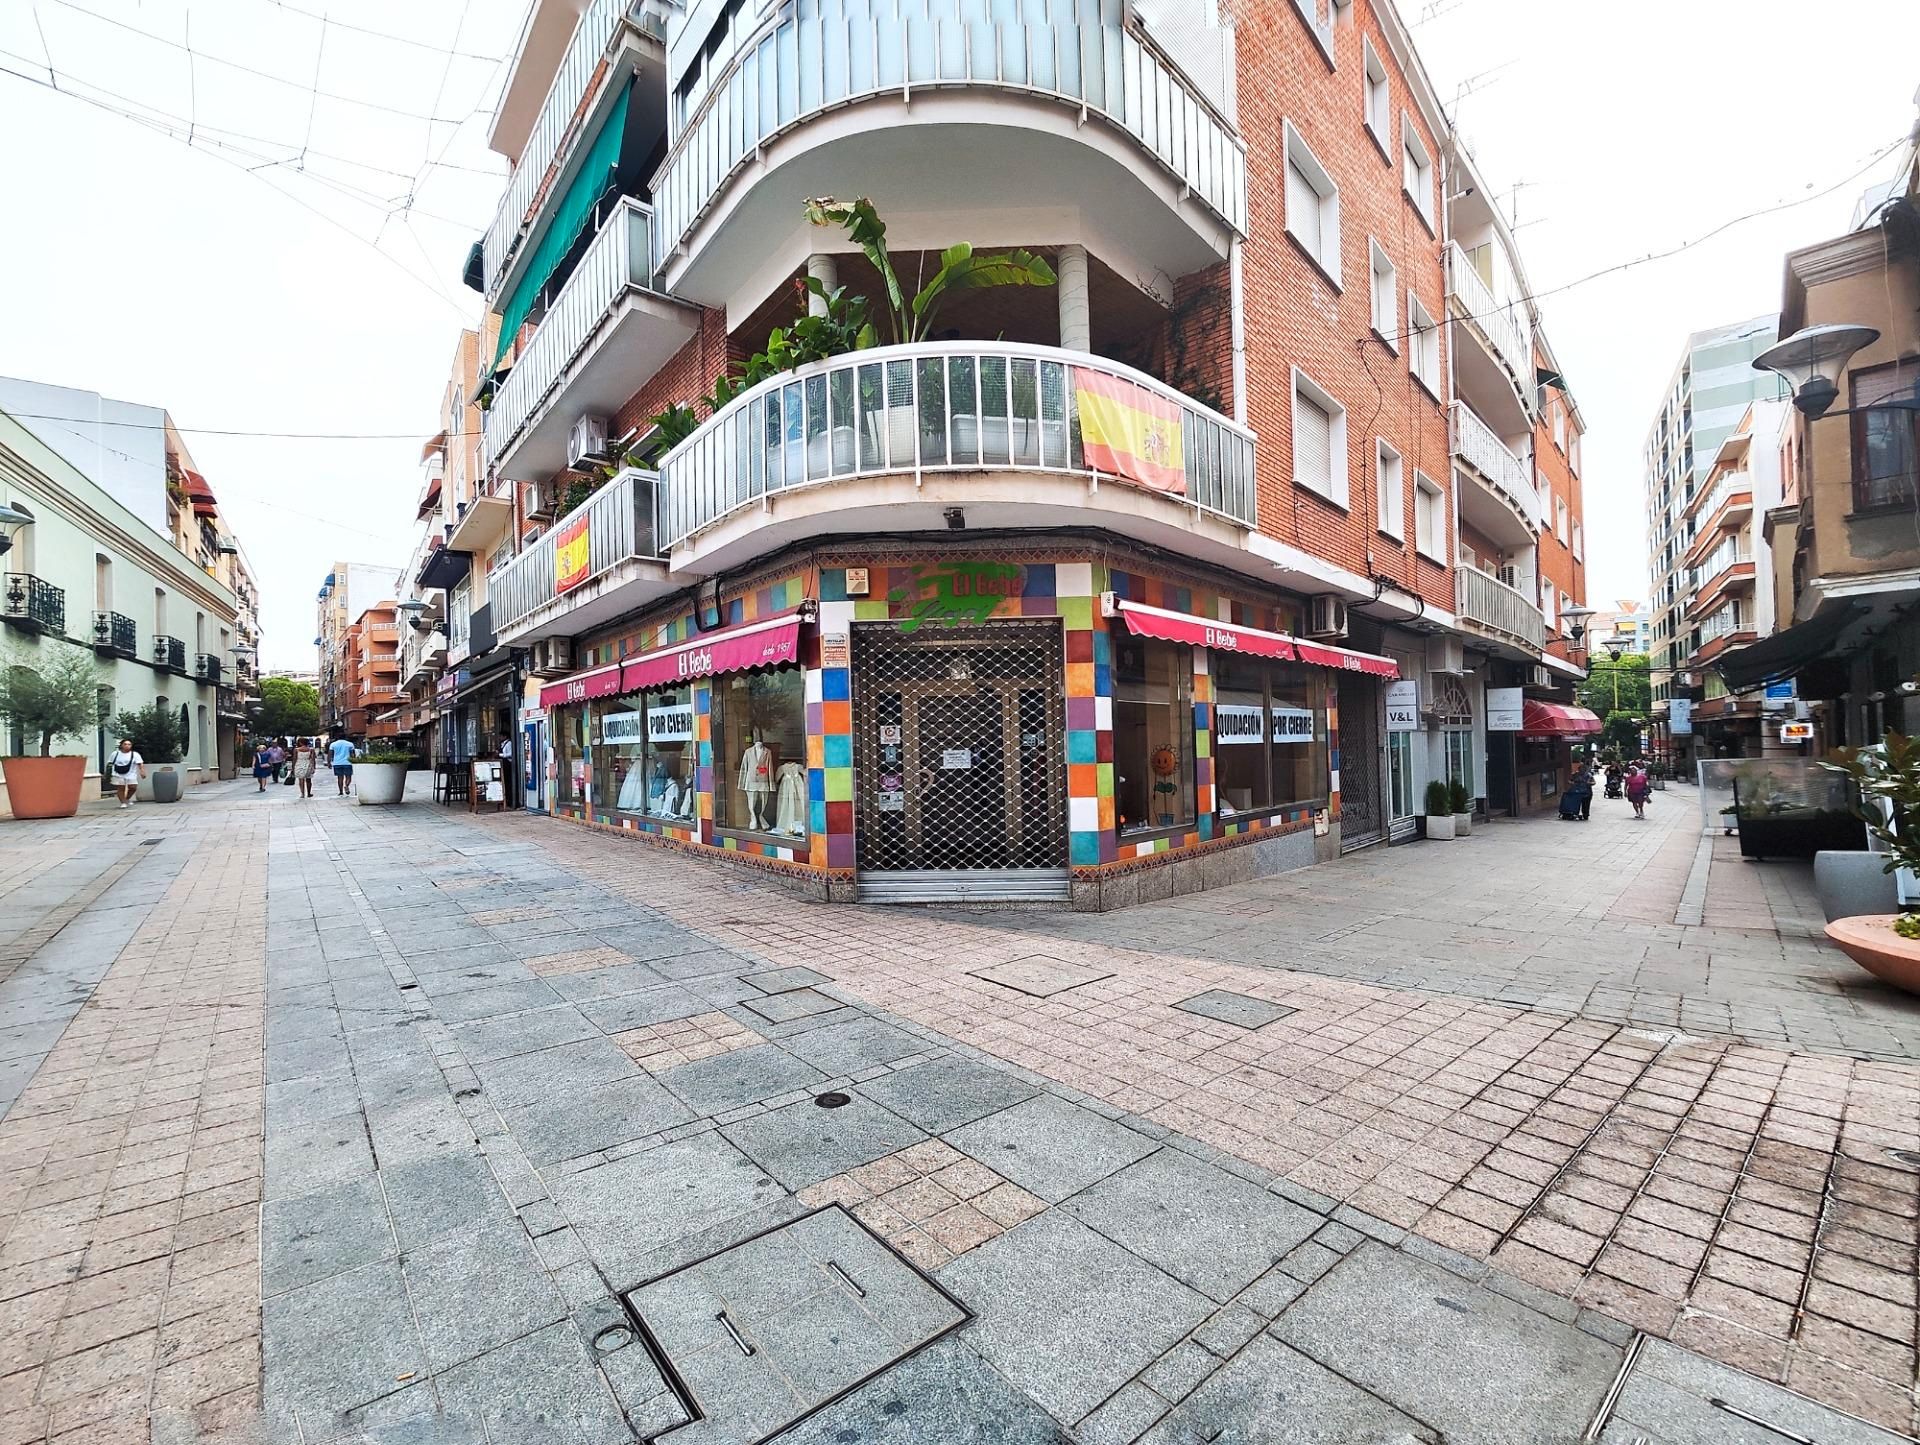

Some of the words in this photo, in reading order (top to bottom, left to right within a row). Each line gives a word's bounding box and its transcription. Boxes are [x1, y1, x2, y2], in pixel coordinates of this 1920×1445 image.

[1206, 628, 1214, 644] El
[1216, 630, 1237, 648] Bebé
[679, 653, 687, 676] El
[689, 647, 712, 674] Bebé
[567, 682, 573, 700] El
[649, 713, 666, 735] POR
[667, 712, 693, 734] CIERR
[1217, 711, 1261, 738] QUIDACIÓN
[1273, 715, 1287, 735] POR
[1288, 715, 1312, 735] CIERRE
[1389, 711, 1414, 722] V&L
[604, 715, 640, 740] LIQUIDACIÓN
